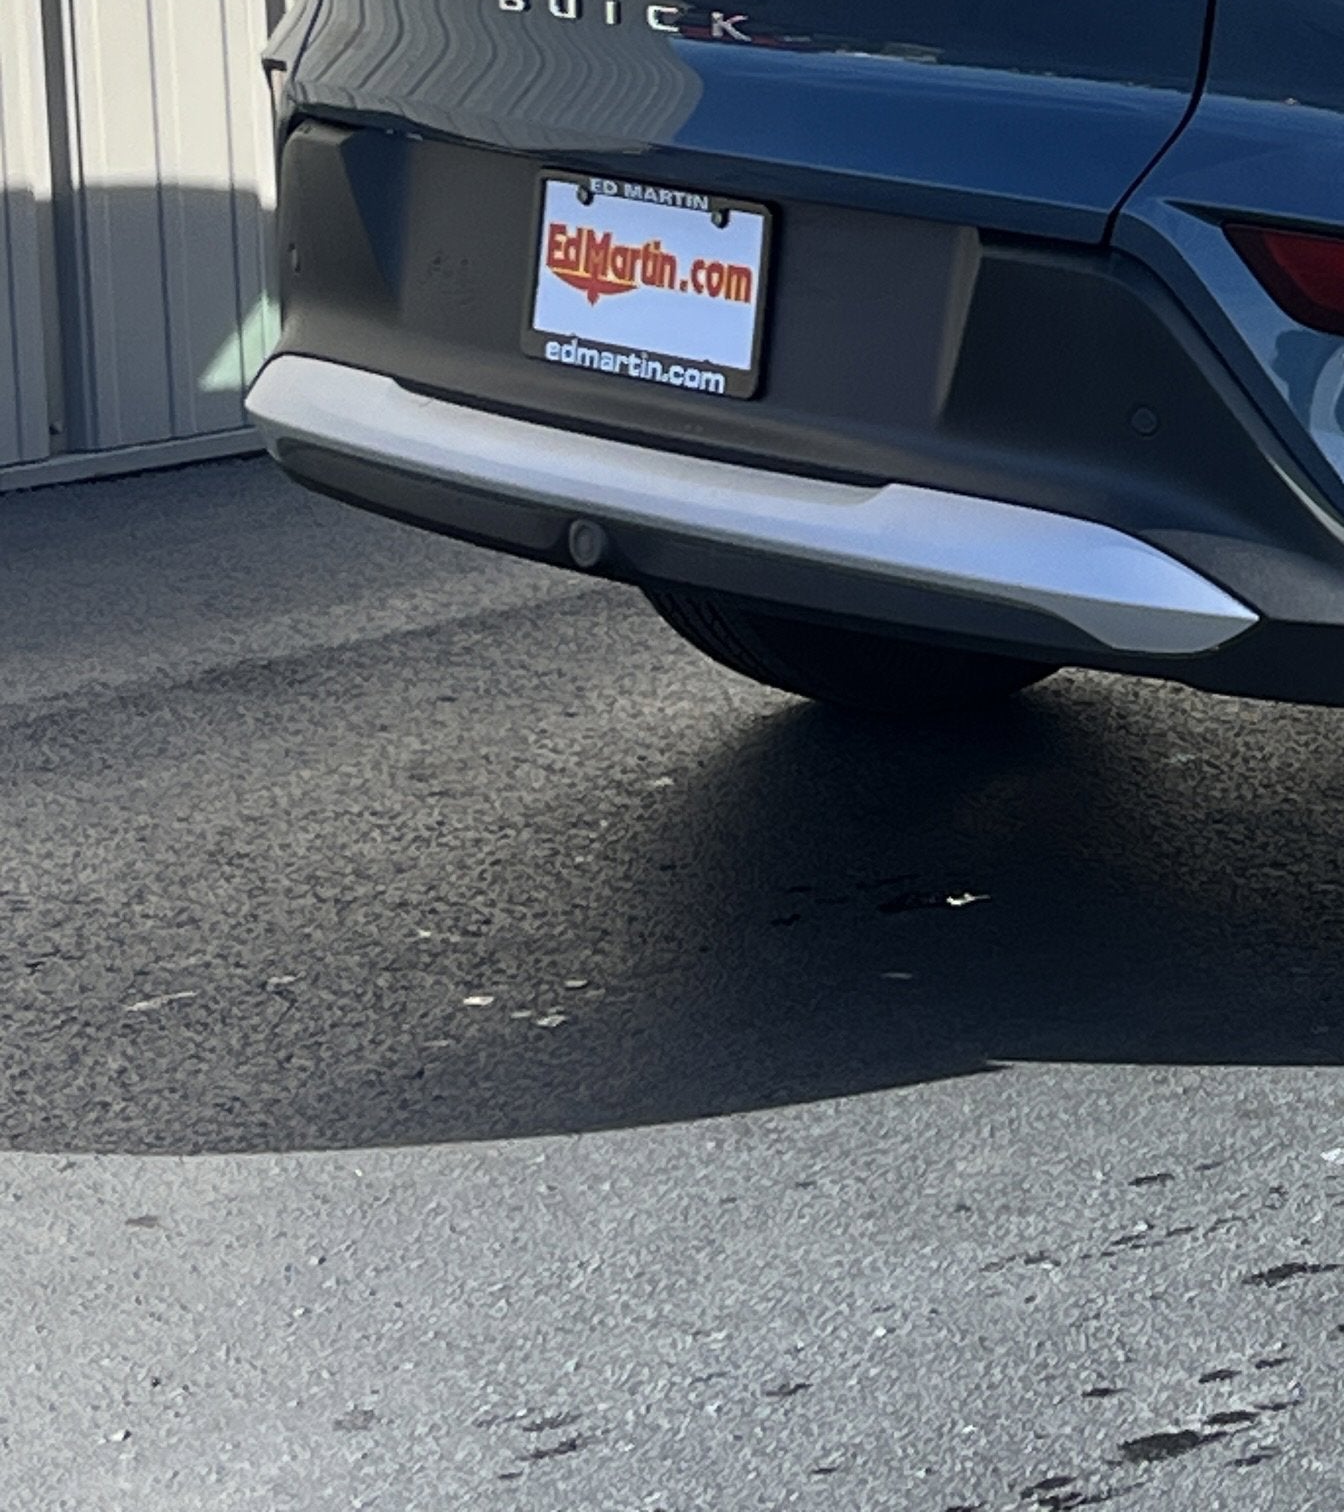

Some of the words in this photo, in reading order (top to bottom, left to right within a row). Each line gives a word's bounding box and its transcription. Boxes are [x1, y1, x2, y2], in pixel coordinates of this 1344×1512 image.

[590, 178, 618, 194] ED
[624, 184, 709, 210] MARTIN
[546, 223, 753, 304] EdMartin.com
[545, 338, 726, 394] edmartin.com
